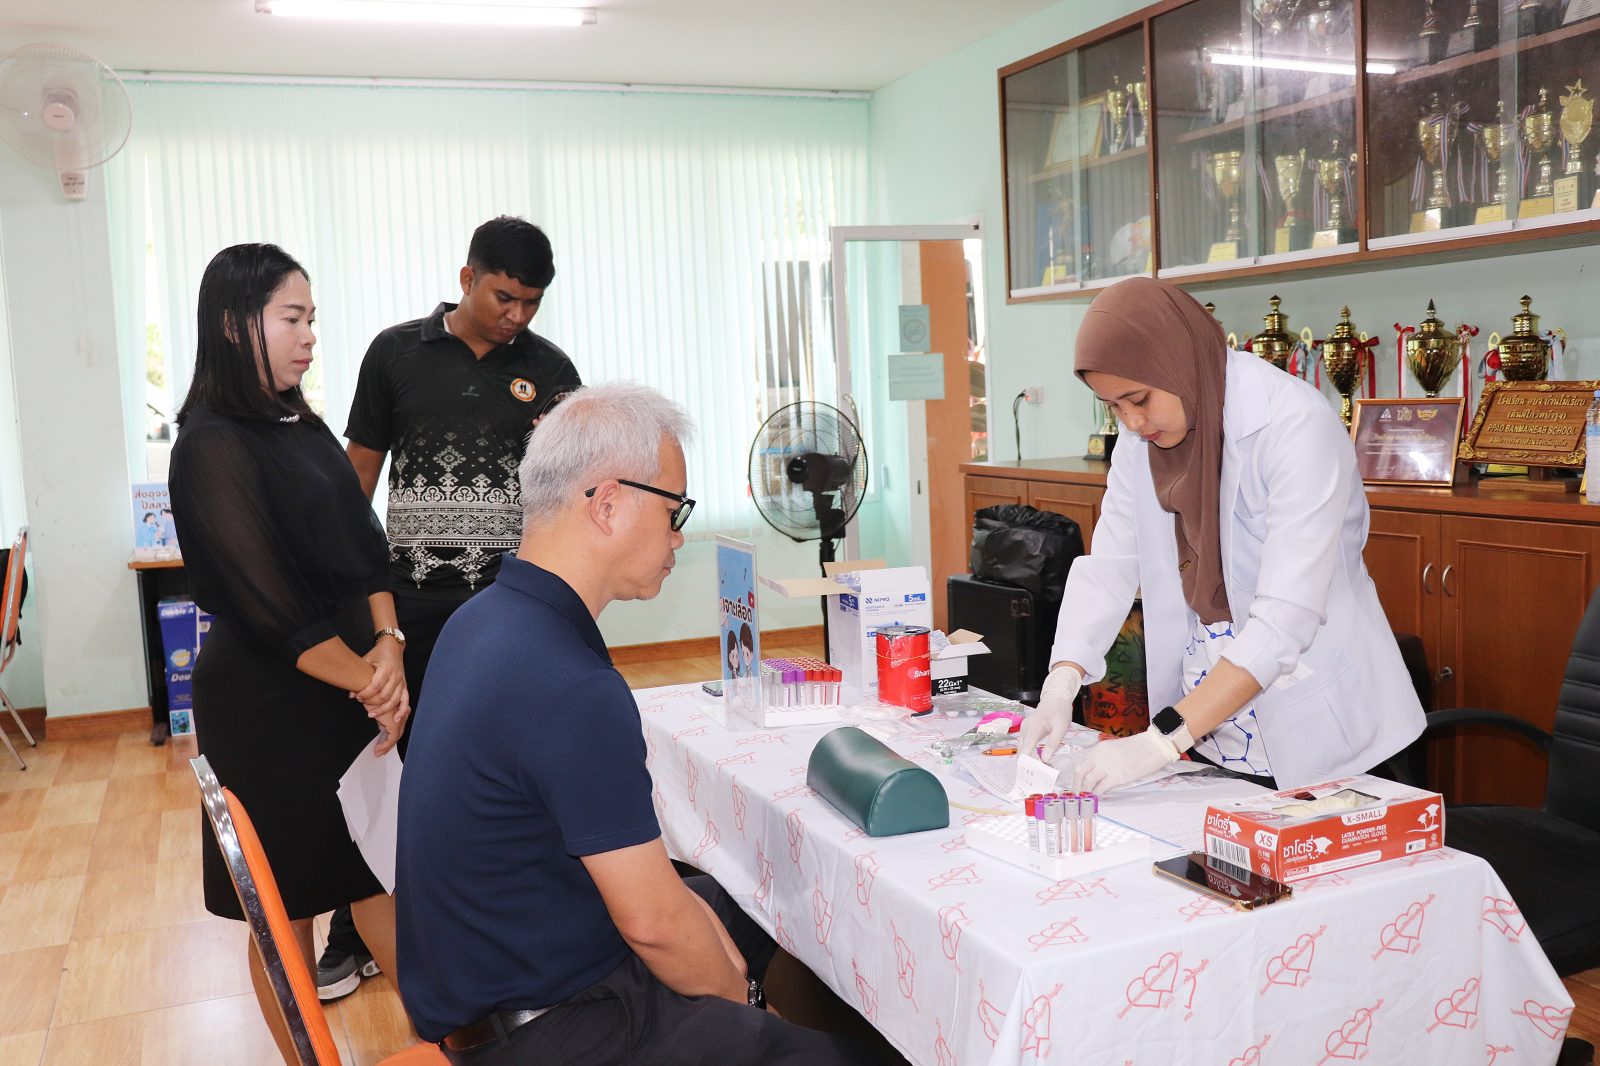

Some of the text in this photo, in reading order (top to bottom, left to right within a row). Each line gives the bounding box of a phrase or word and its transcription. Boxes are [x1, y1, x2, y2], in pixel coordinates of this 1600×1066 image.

[1547, 425, 1577, 435] SCHOOL
[914, 669, 930, 678] Shar
[1346, 809, 1383, 824] X-SMALL
[1259, 833, 1273, 847] XS
